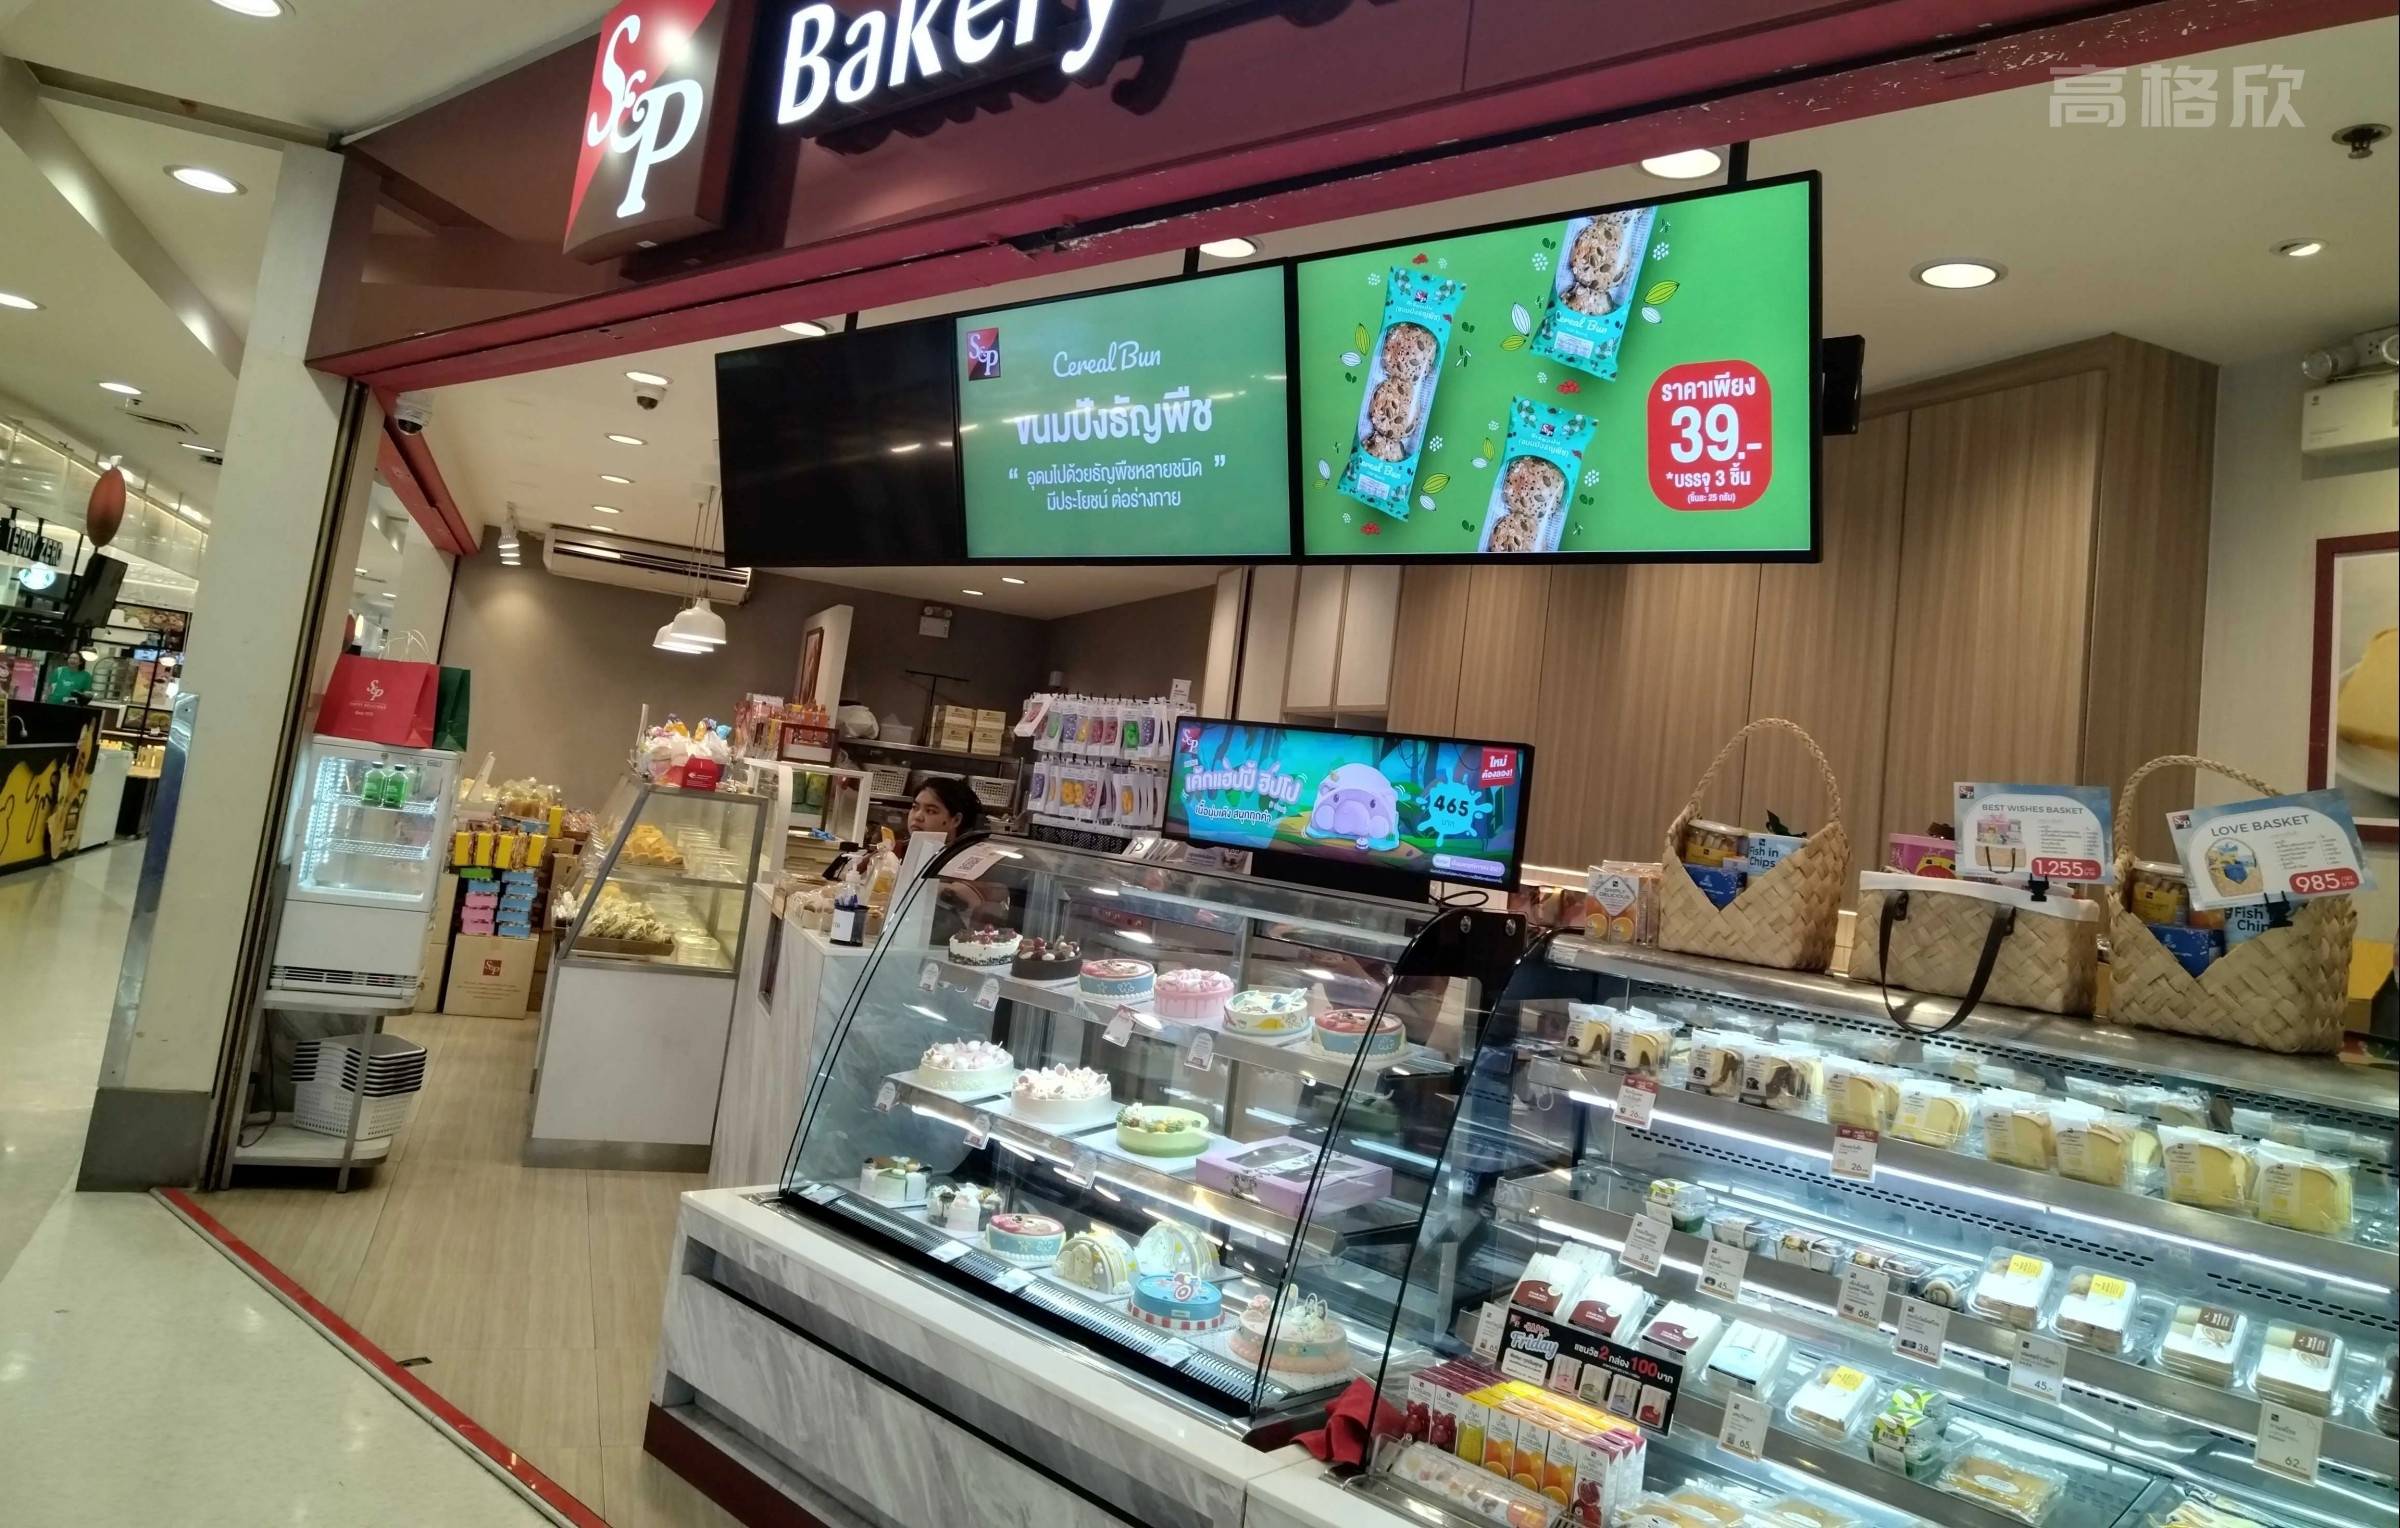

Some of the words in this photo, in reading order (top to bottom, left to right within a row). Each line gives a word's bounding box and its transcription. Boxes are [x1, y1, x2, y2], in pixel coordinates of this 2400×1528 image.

[778, 0, 1111, 125] Bakery
[1053, 342, 1117, 378] Cereal
[1121, 340, 1161, 367] Bun
[1661, 372, 1756, 401] ราคาเพียง
[1014, 386, 1212, 445] ขนมปังธัญพืช
[1670, 403, 1762, 463] 39.-
[1715, 470, 1725, 487] 3
[1730, 462, 1751, 486] ชิ้น
[1047, 488, 1108, 511] มีประโยชน์
[1111, 487, 1181, 508] ต่อร่างกาย
[1489, 754, 1508, 768] ใหม่
[1434, 795, 1469, 816] 465
[1982, 803, 2005, 812] BEST
[2007, 805, 2044, 813] WISHES
[2046, 806, 2083, 815] BASKET
[2211, 822, 2250, 837] LOVE
[2252, 814, 2310, 832] BASKET
[1750, 857, 1776, 869] Chips
[1768, 848, 1779, 857] in
[2296, 873, 2340, 892] 985
[2234, 908, 2264, 920] Fish
[1510, 1331, 1559, 1360] Friday
[1599, 1345, 1609, 1360] 2
[1608, 1355, 1630, 1369] กล่อง
[1631, 1357, 1658, 1377] 100
[1657, 1371, 1674, 1384] บาท
